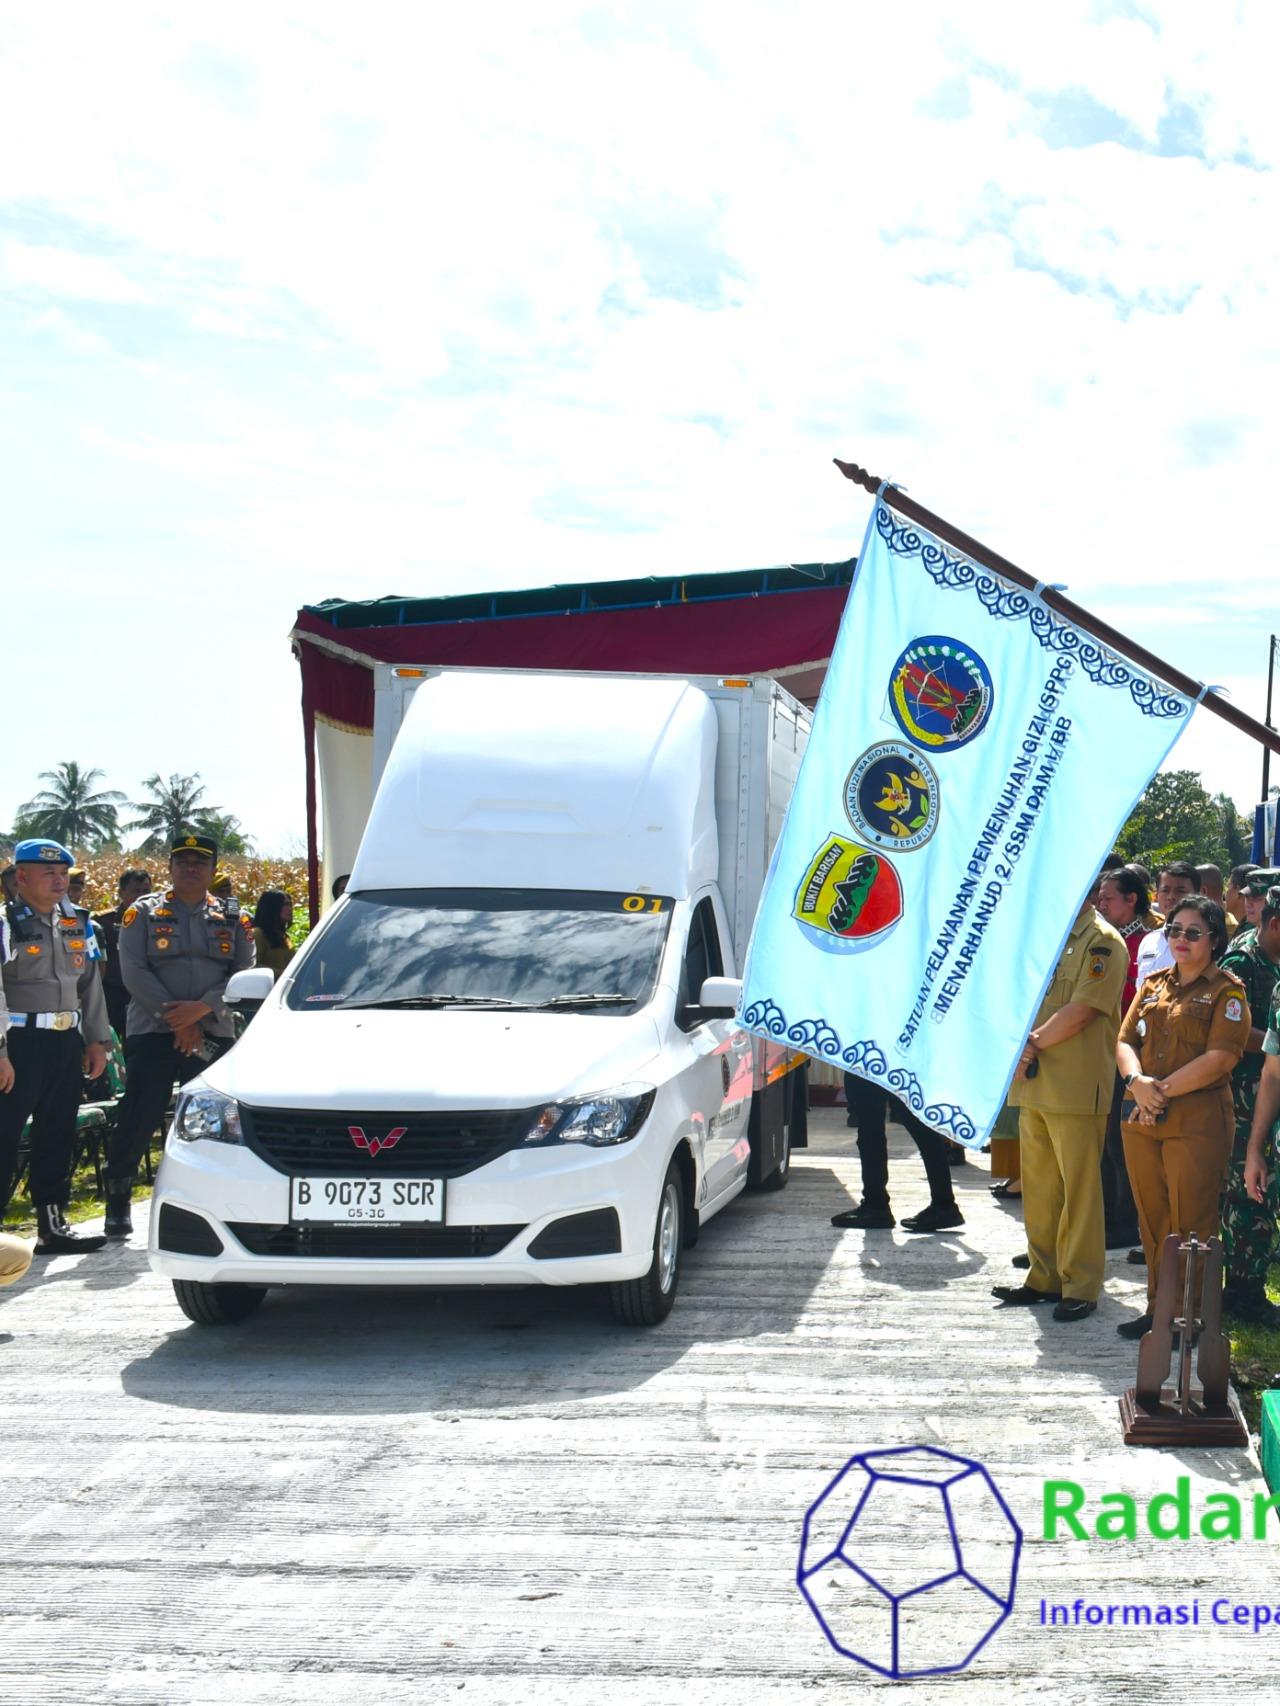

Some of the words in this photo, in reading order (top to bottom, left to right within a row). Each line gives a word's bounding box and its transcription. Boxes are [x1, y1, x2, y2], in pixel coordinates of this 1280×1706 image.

[858, 745, 901, 773] NASIONAL
[849, 773, 860, 793] GIZI
[849, 796, 866, 830] BADAN
[894, 823, 932, 848] REPUBLIK
[918, 760, 937, 821] INDONESIA
[898, 981, 932, 1048] SATUAN
[924, 877, 979, 983] PELAYANAN
[966, 756, 1032, 876] PEMENUHAN
[1022, 714, 1048, 754] GIZI
[1038, 651, 1079, 713] (SPPG)
[803, 884, 820, 911] BUKIT
[812, 845, 841, 885] BARISAN
[933, 880, 1004, 1015] MENARHANUD
[994, 811, 1036, 880] 2/SSM
[1026, 765, 1054, 811] DAM
[623, 896, 662, 913] 01
[298, 1182, 311, 1205] B
[325, 1182, 381, 1205] 9073
[393, 1182, 435, 1206] SCR
